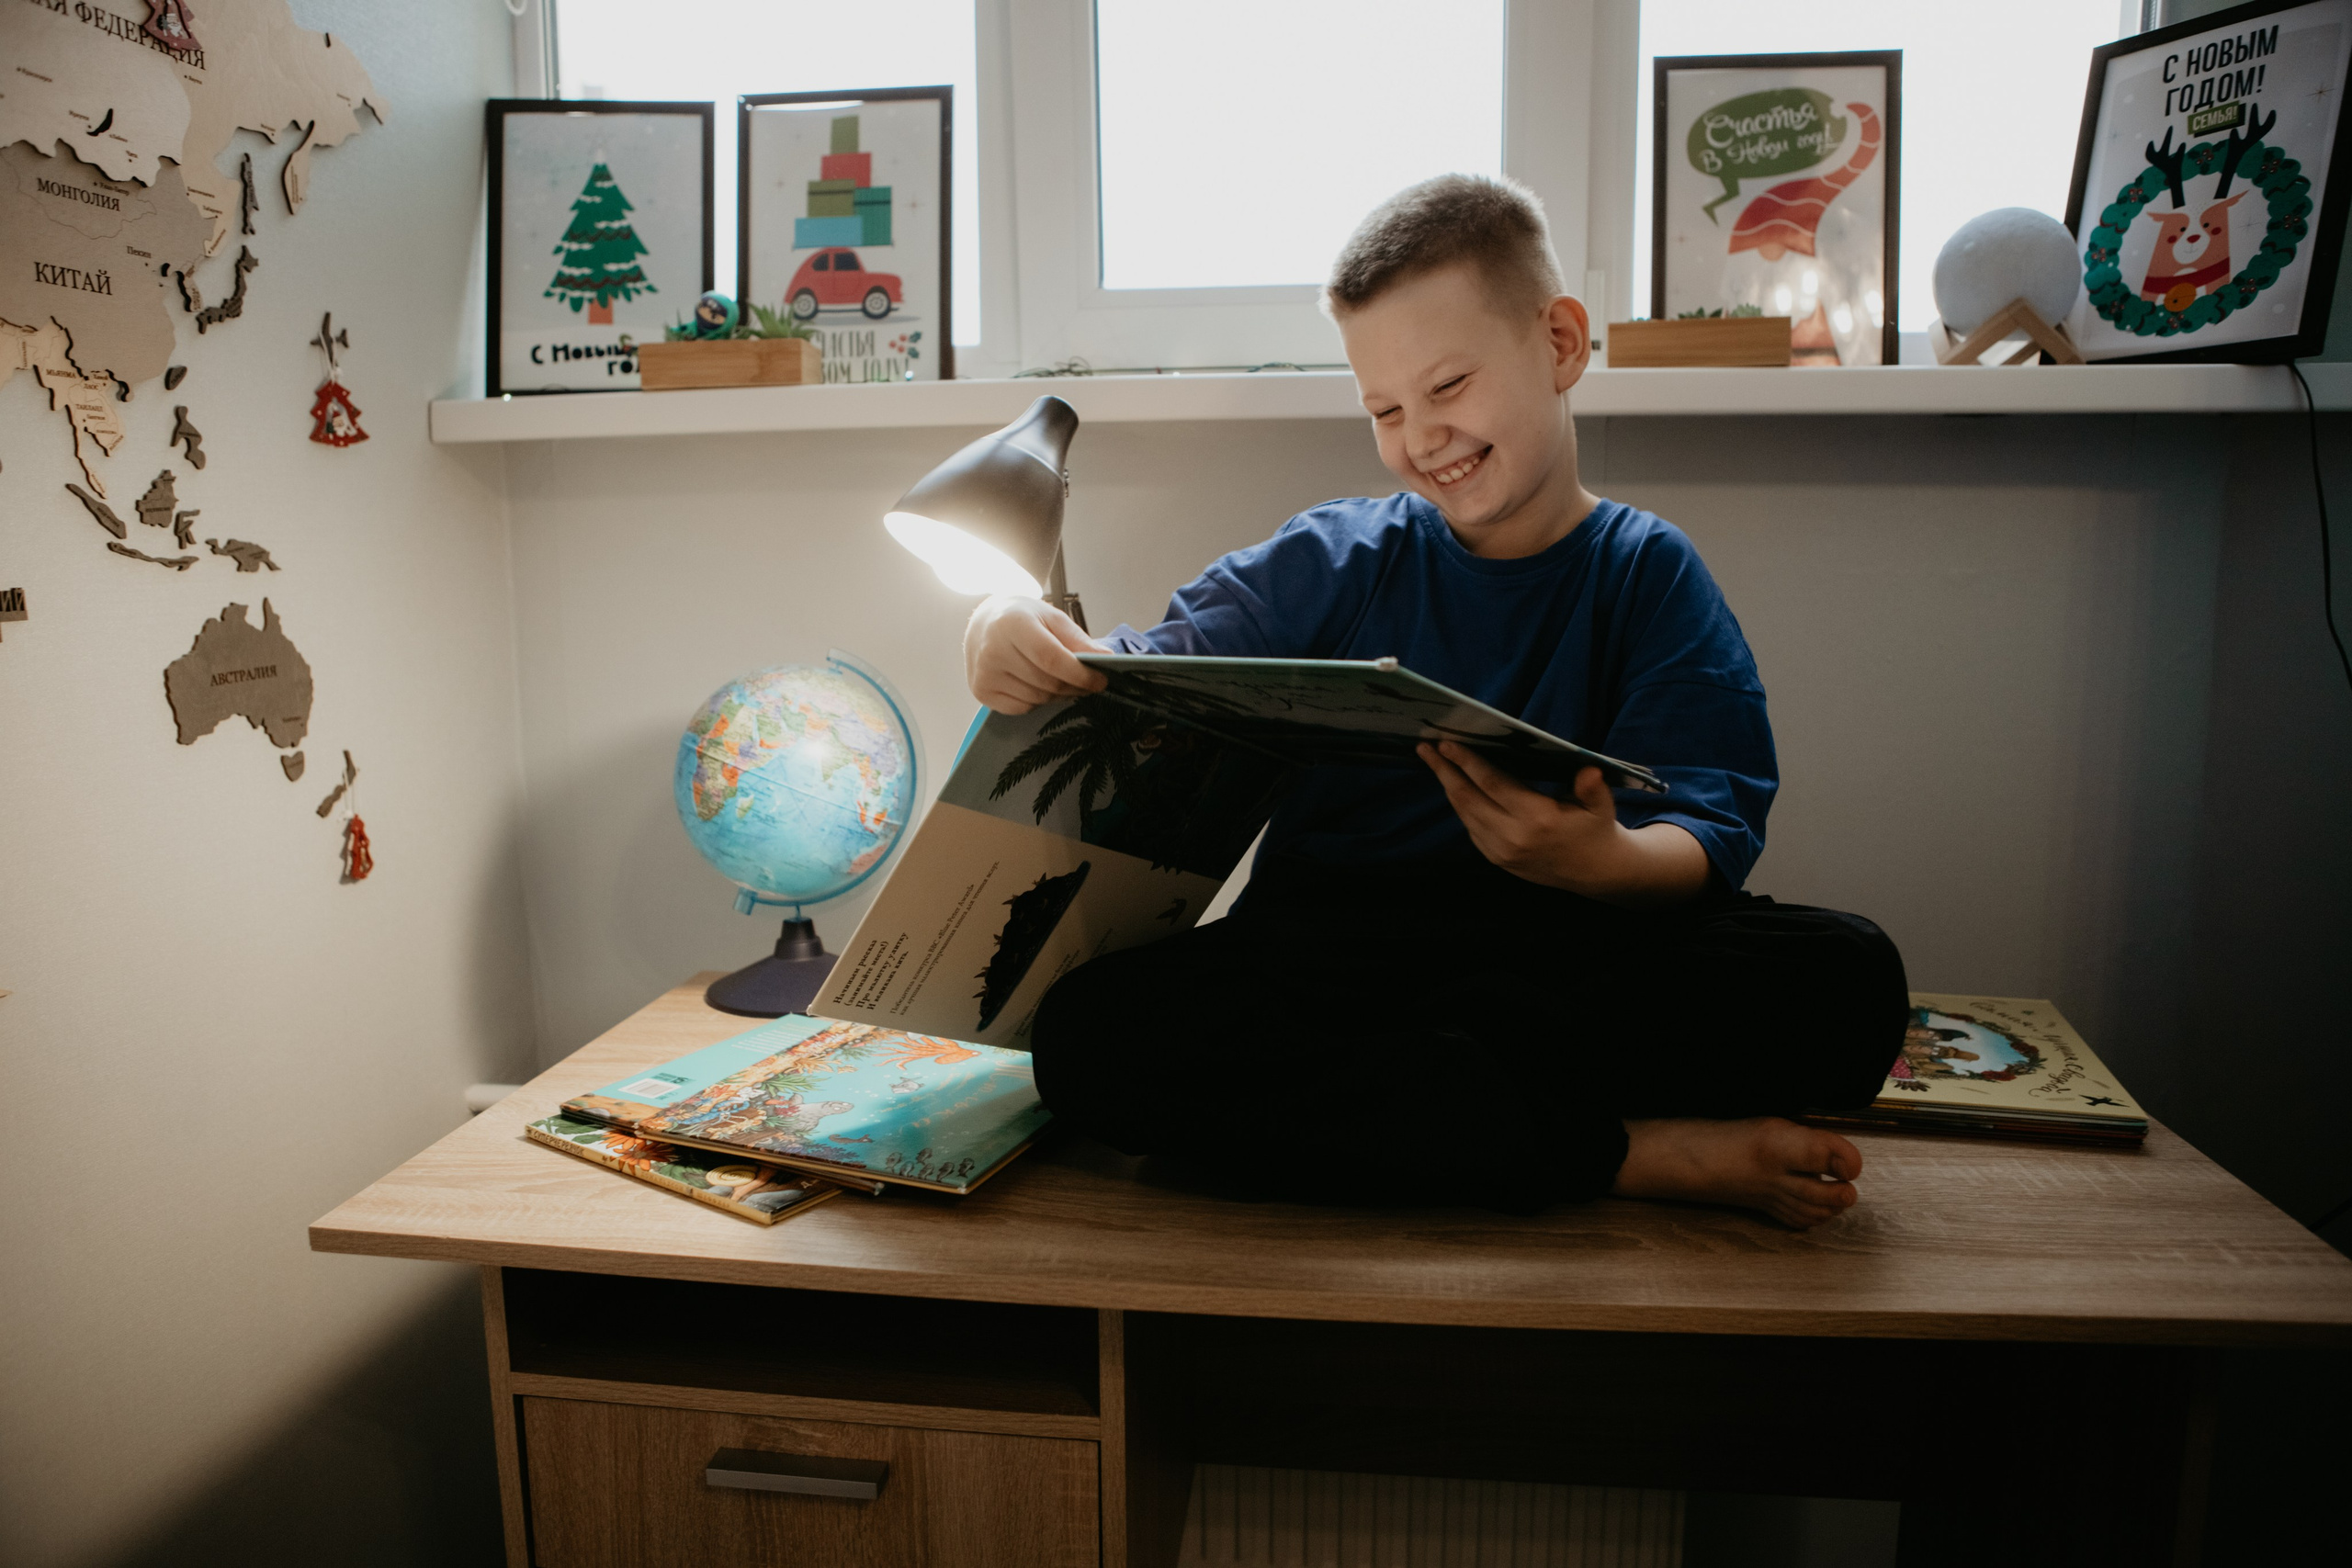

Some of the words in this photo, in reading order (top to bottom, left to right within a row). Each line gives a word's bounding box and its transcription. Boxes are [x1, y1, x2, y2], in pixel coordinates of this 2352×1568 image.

[2163, 54, 2179, 84] С
[2186, 24, 2279, 77] НОВЫМ
[2165, 64, 2266, 117] ГОДОМ!
[2192, 105, 2238, 131] СЕМЬЯ!
[37, 177, 120, 211] МОНГОЛИЯ
[34, 261, 113, 296] КИТАЙ
[210, 664, 277, 686] АВСТРАЛИЯ
[832, 967, 861, 1004] Начинаем
[857, 940, 877, 967] рассказ
[855, 992, 871, 1008] Про
[868, 961, 891, 992] малютку
